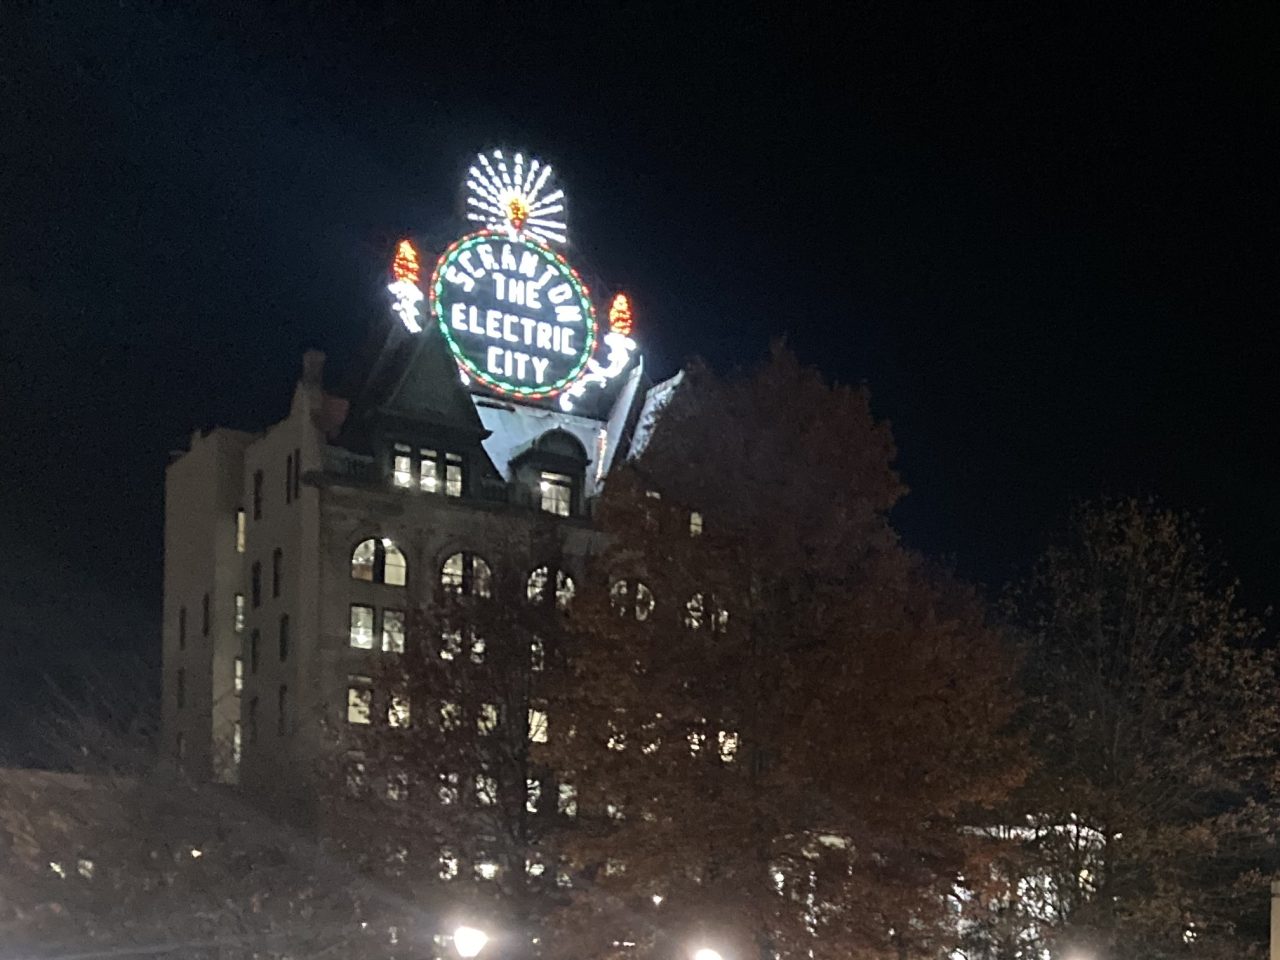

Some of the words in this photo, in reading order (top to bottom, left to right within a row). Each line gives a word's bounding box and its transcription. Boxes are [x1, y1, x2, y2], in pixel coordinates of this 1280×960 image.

[446, 244, 582, 322] SCRANTON
[492, 272, 542, 309] THE
[452, 303, 577, 356] ELECTRIC
[487, 346, 549, 384] CITY
